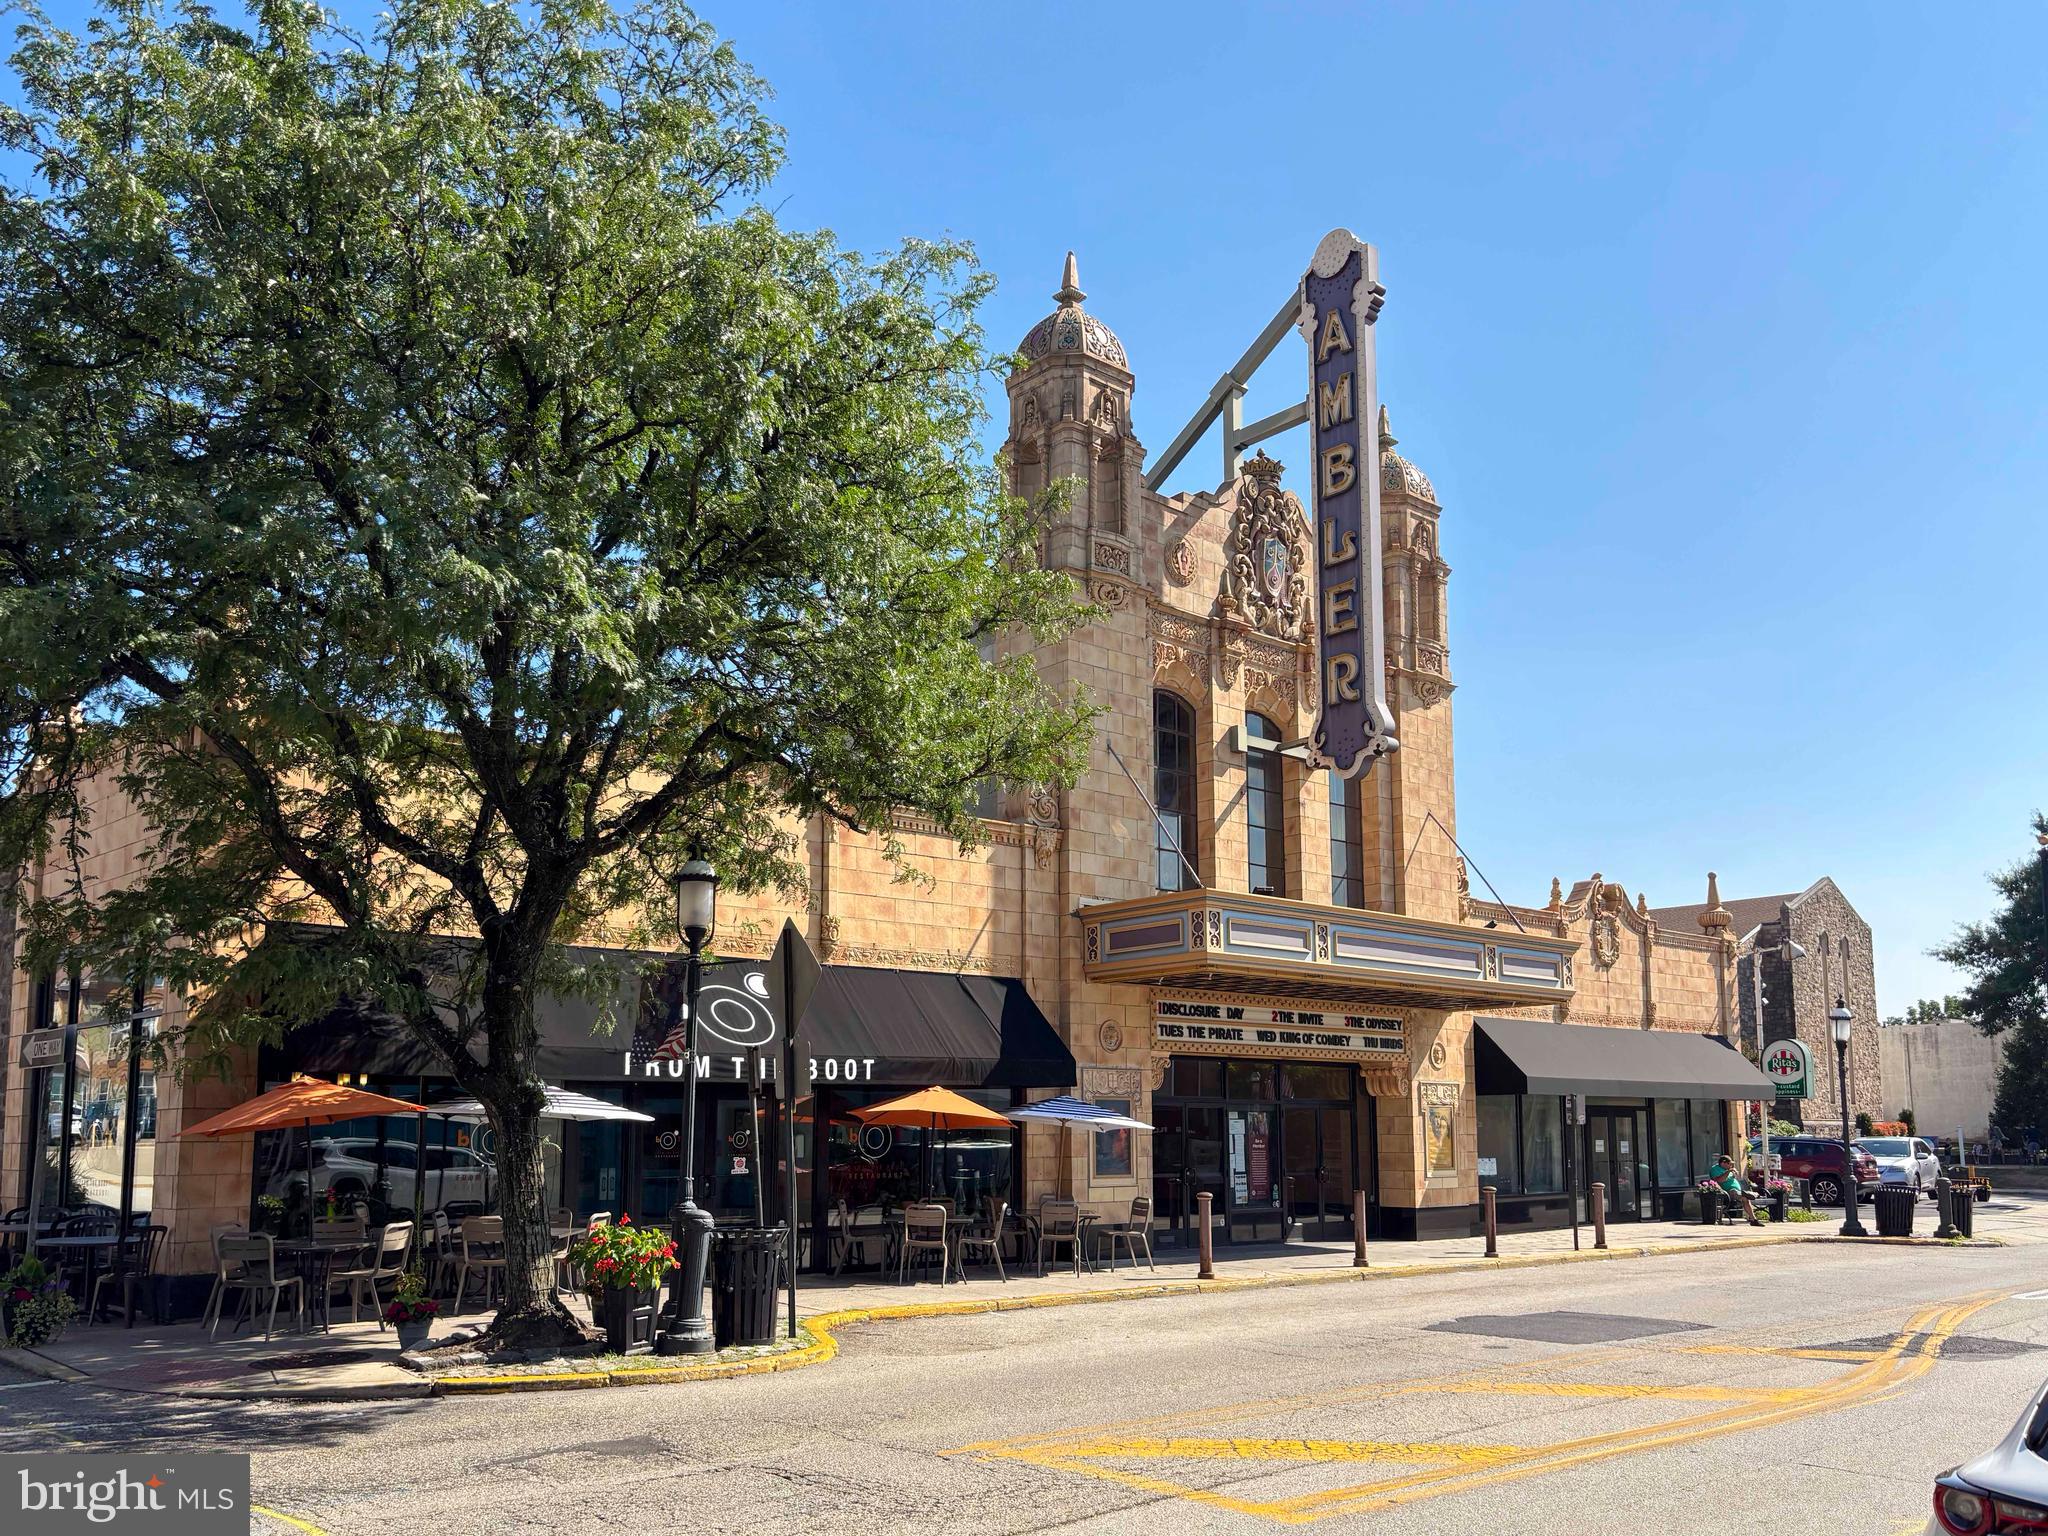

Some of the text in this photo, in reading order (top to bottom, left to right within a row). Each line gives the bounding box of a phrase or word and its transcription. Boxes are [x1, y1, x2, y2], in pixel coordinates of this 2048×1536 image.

[1316, 307, 1361, 707] AMBLER
[1226, 1007, 1245, 1020] DAY
[1278, 1011, 1295, 1024] THE
[1350, 1017, 1365, 1029] THE
[1365, 1018, 1403, 1031] ODYSSEY
[1158, 1024, 1184, 1037] TUES
[1187, 1026, 1206, 1039] THE
[1208, 1027, 1244, 1041] PIRATE
[1256, 1030, 1277, 1043] WED
[1279, 1031, 1301, 1044] KING
[1302, 1033, 1315, 1045] OF
[34, 1042, 48, 1057] ONE
